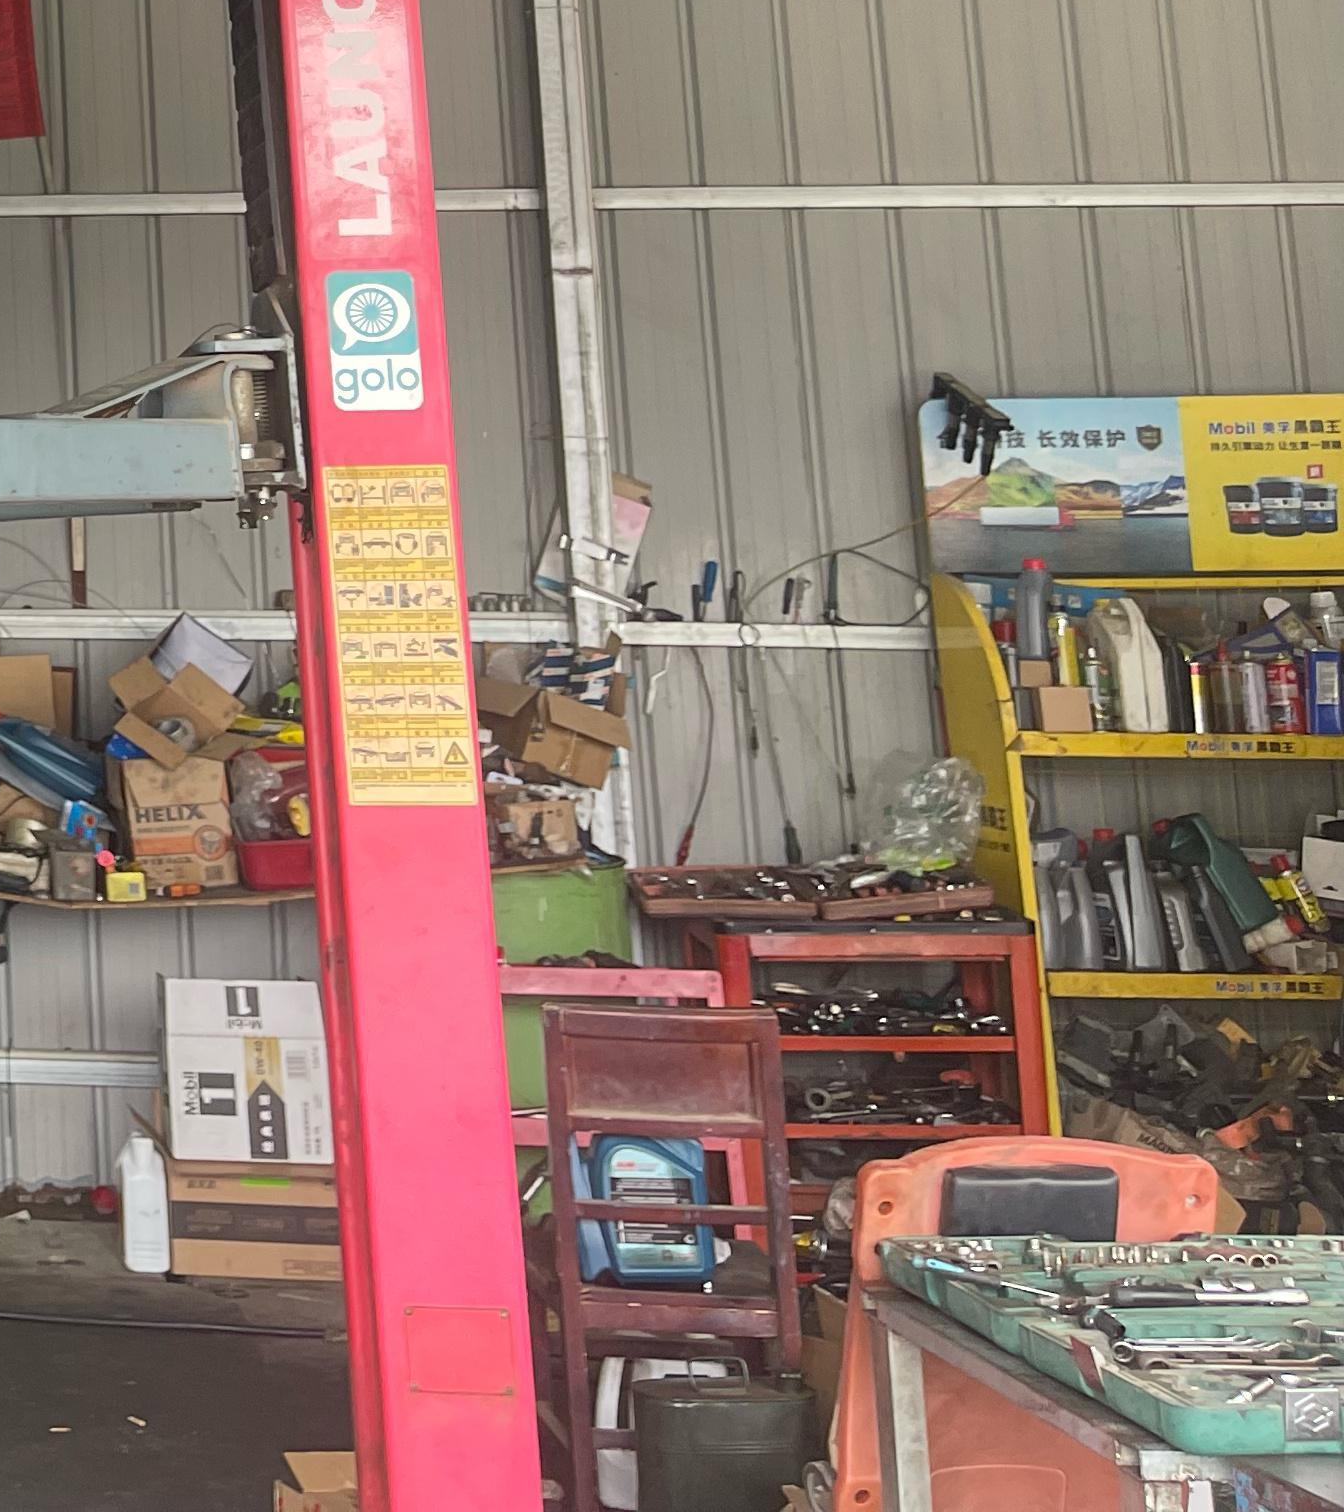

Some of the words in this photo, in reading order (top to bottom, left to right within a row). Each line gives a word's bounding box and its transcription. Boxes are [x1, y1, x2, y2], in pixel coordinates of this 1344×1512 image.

[335, 358, 420, 404] golo
[1208, 422, 1255, 434] Mobil
[1038, 429, 1126, 449] 长效保护
[135, 805, 208, 823] HELIX
[183, 1071, 198, 1115] Mobil
